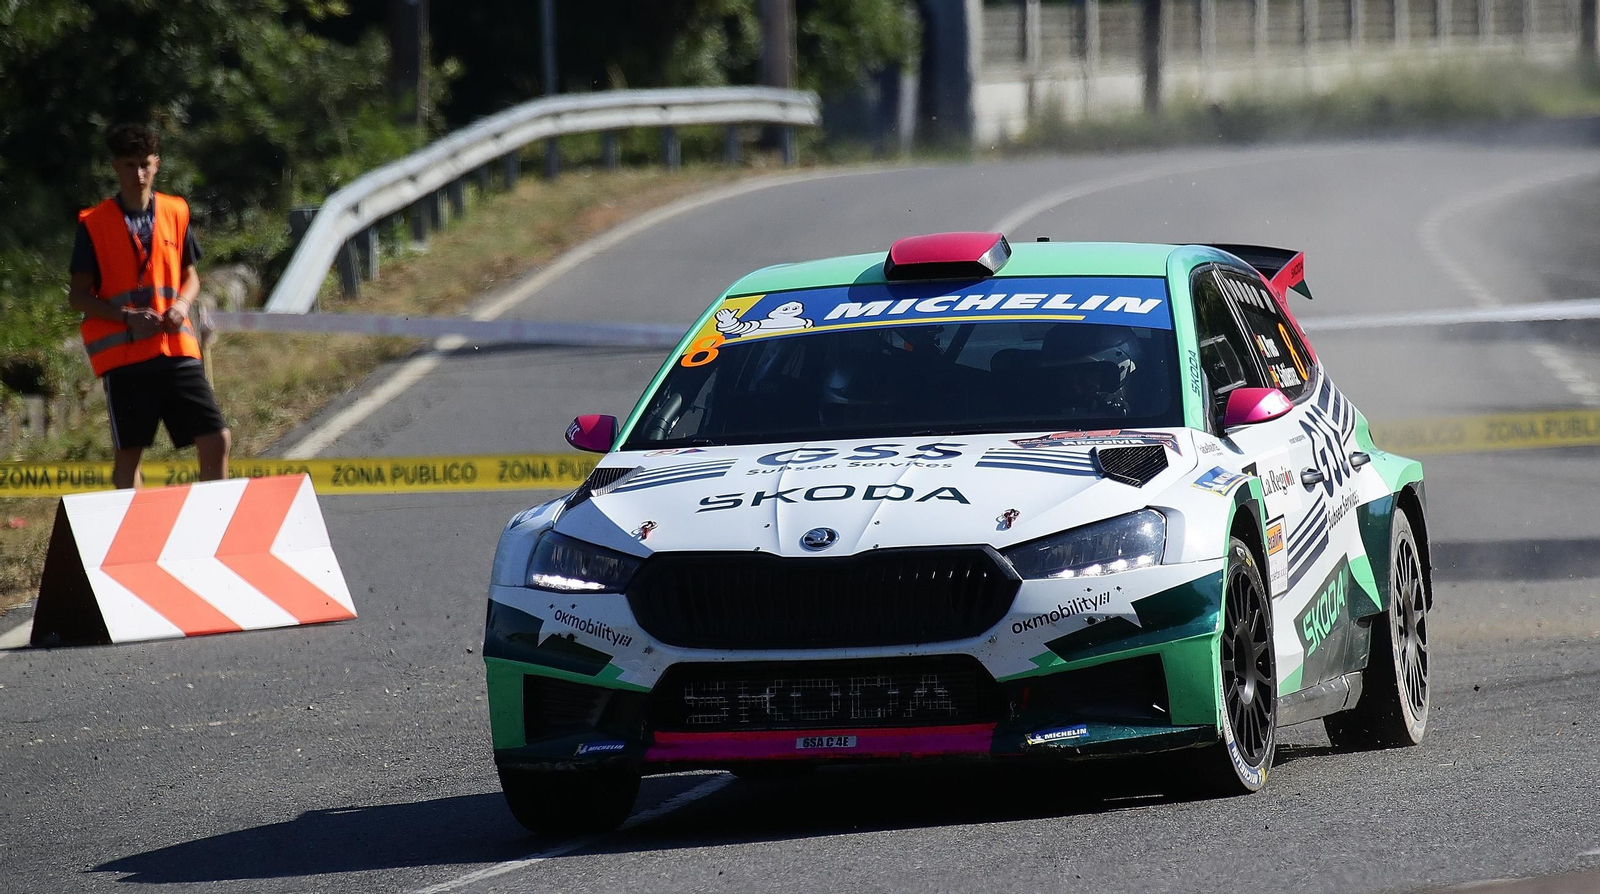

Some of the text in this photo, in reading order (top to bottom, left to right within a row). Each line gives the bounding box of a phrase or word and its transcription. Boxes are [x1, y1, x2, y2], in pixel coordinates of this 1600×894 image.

[824, 293, 1163, 321] MICHELIN
[680, 335, 726, 367] 8
[1277, 322, 1309, 381] 8
[1187, 349, 1201, 398] SKODA
[757, 442, 969, 466] GSS
[0, 467, 52, 490] ZONA
[331, 461, 478, 487] ZONA PUBLICO
[498, 460, 552, 482] ZONA
[745, 461, 953, 476] Subsea Services
[694, 484, 972, 514] SKODA
[1259, 475, 1273, 497] La
[1327, 502, 1343, 531] Subsea
[554, 609, 621, 647] okmobility
[1011, 595, 1098, 634] okmobility
[1303, 570, 1345, 658] SKODA
[684, 674, 958, 723] SKODA
[1044, 728, 1087, 739] MICHELIN
[587, 744, 625, 752] MICHELIN
